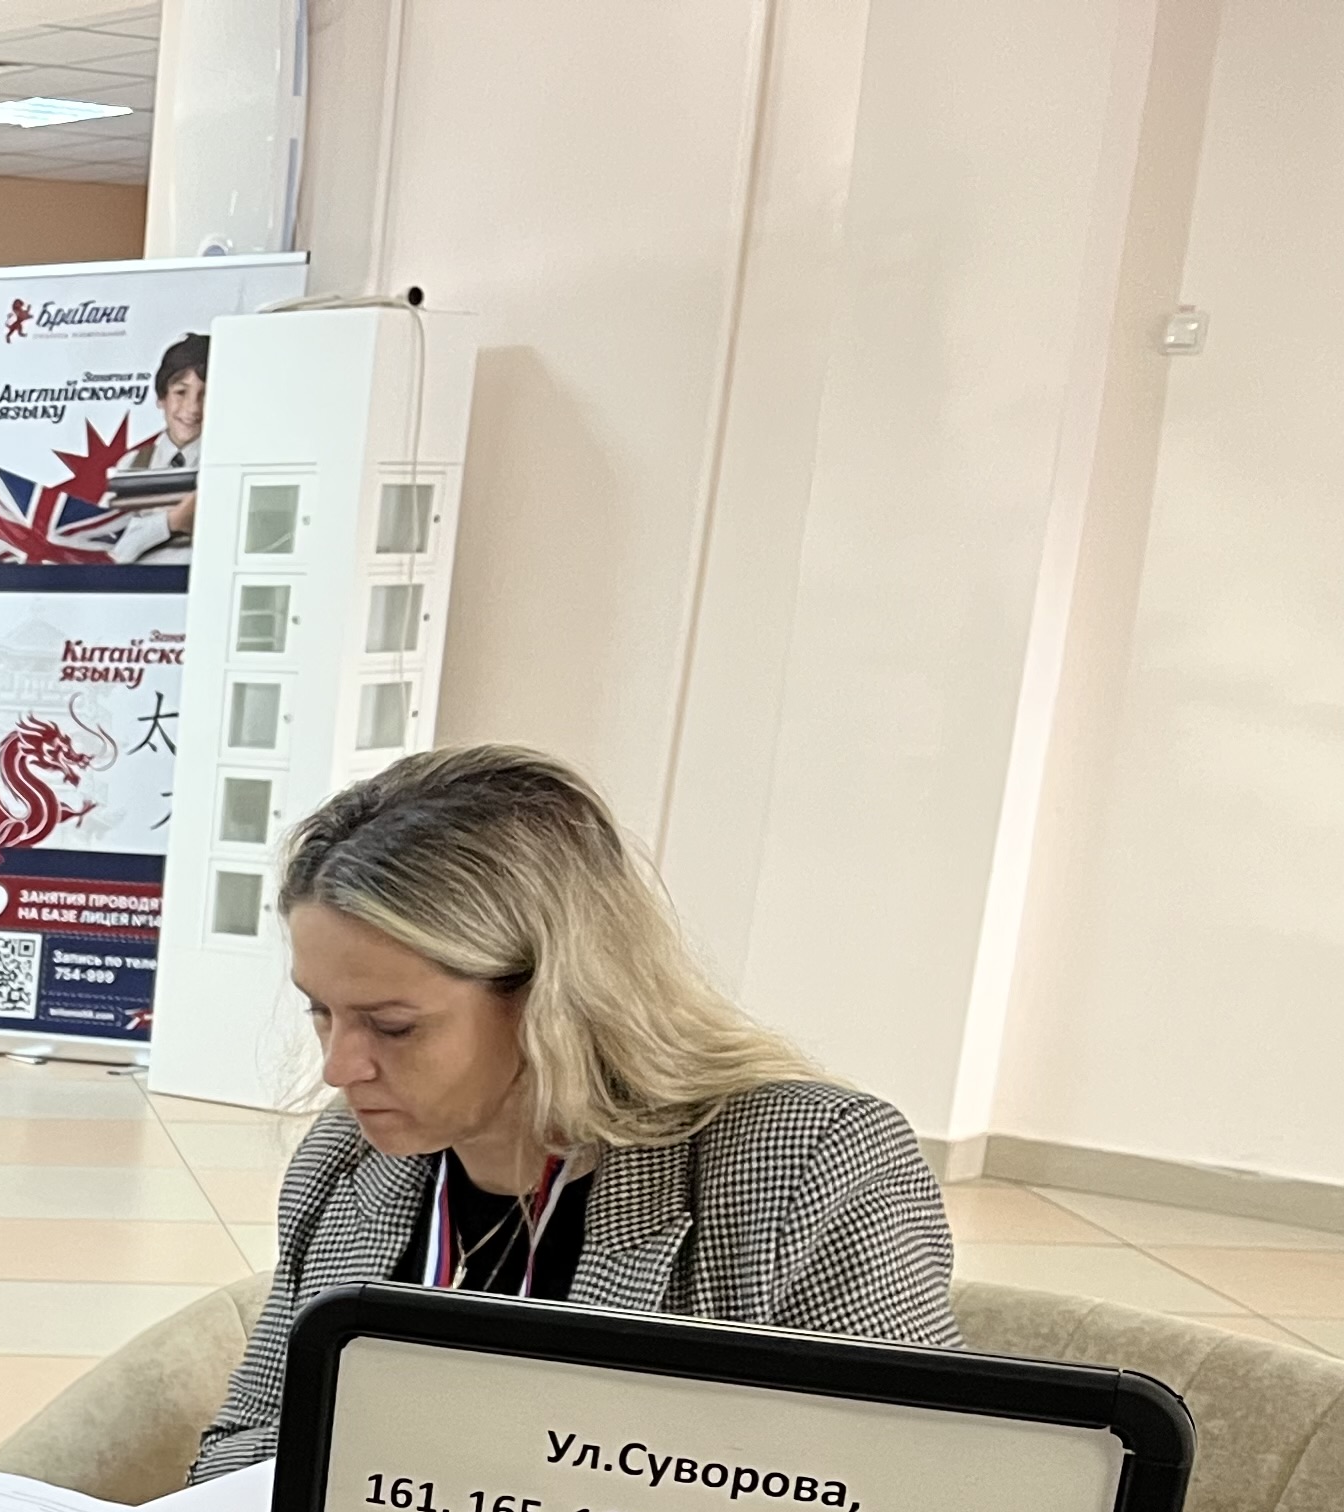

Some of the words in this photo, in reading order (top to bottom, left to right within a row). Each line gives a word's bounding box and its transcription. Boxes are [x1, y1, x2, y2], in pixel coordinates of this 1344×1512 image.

[59, 666, 145, 690] языку
[19, 889, 86, 906] ЗАНЯТИЯ
[17, 907, 39, 920] НА
[41, 908, 78, 923] БАЗЕ
[79, 910, 129, 927] ЛИЦЕЯ
[105, 956, 122, 968] по
